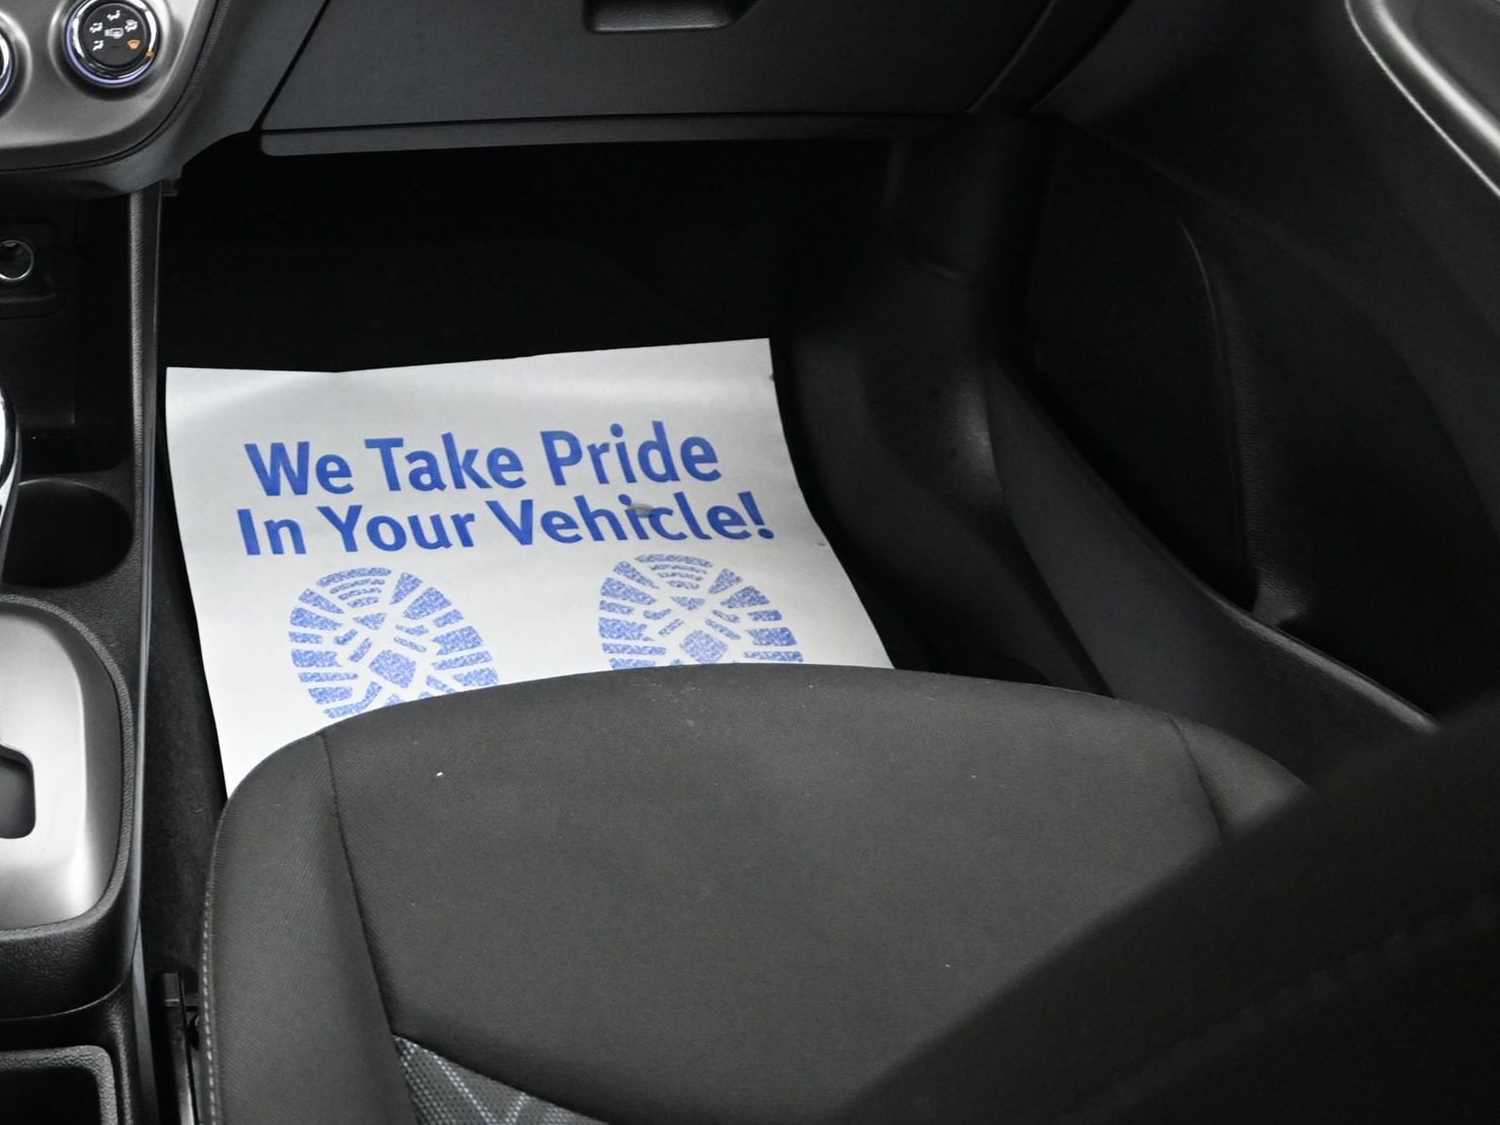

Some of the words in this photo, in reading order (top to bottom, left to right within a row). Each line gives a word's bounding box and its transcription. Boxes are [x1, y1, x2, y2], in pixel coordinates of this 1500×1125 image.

[244, 441, 353, 497] We
[364, 431, 525, 493] Take
[539, 420, 722, 488] Pride
[236, 506, 307, 557] In
[316, 503, 476, 553] Your
[486, 491, 775, 547] Vehicle!
